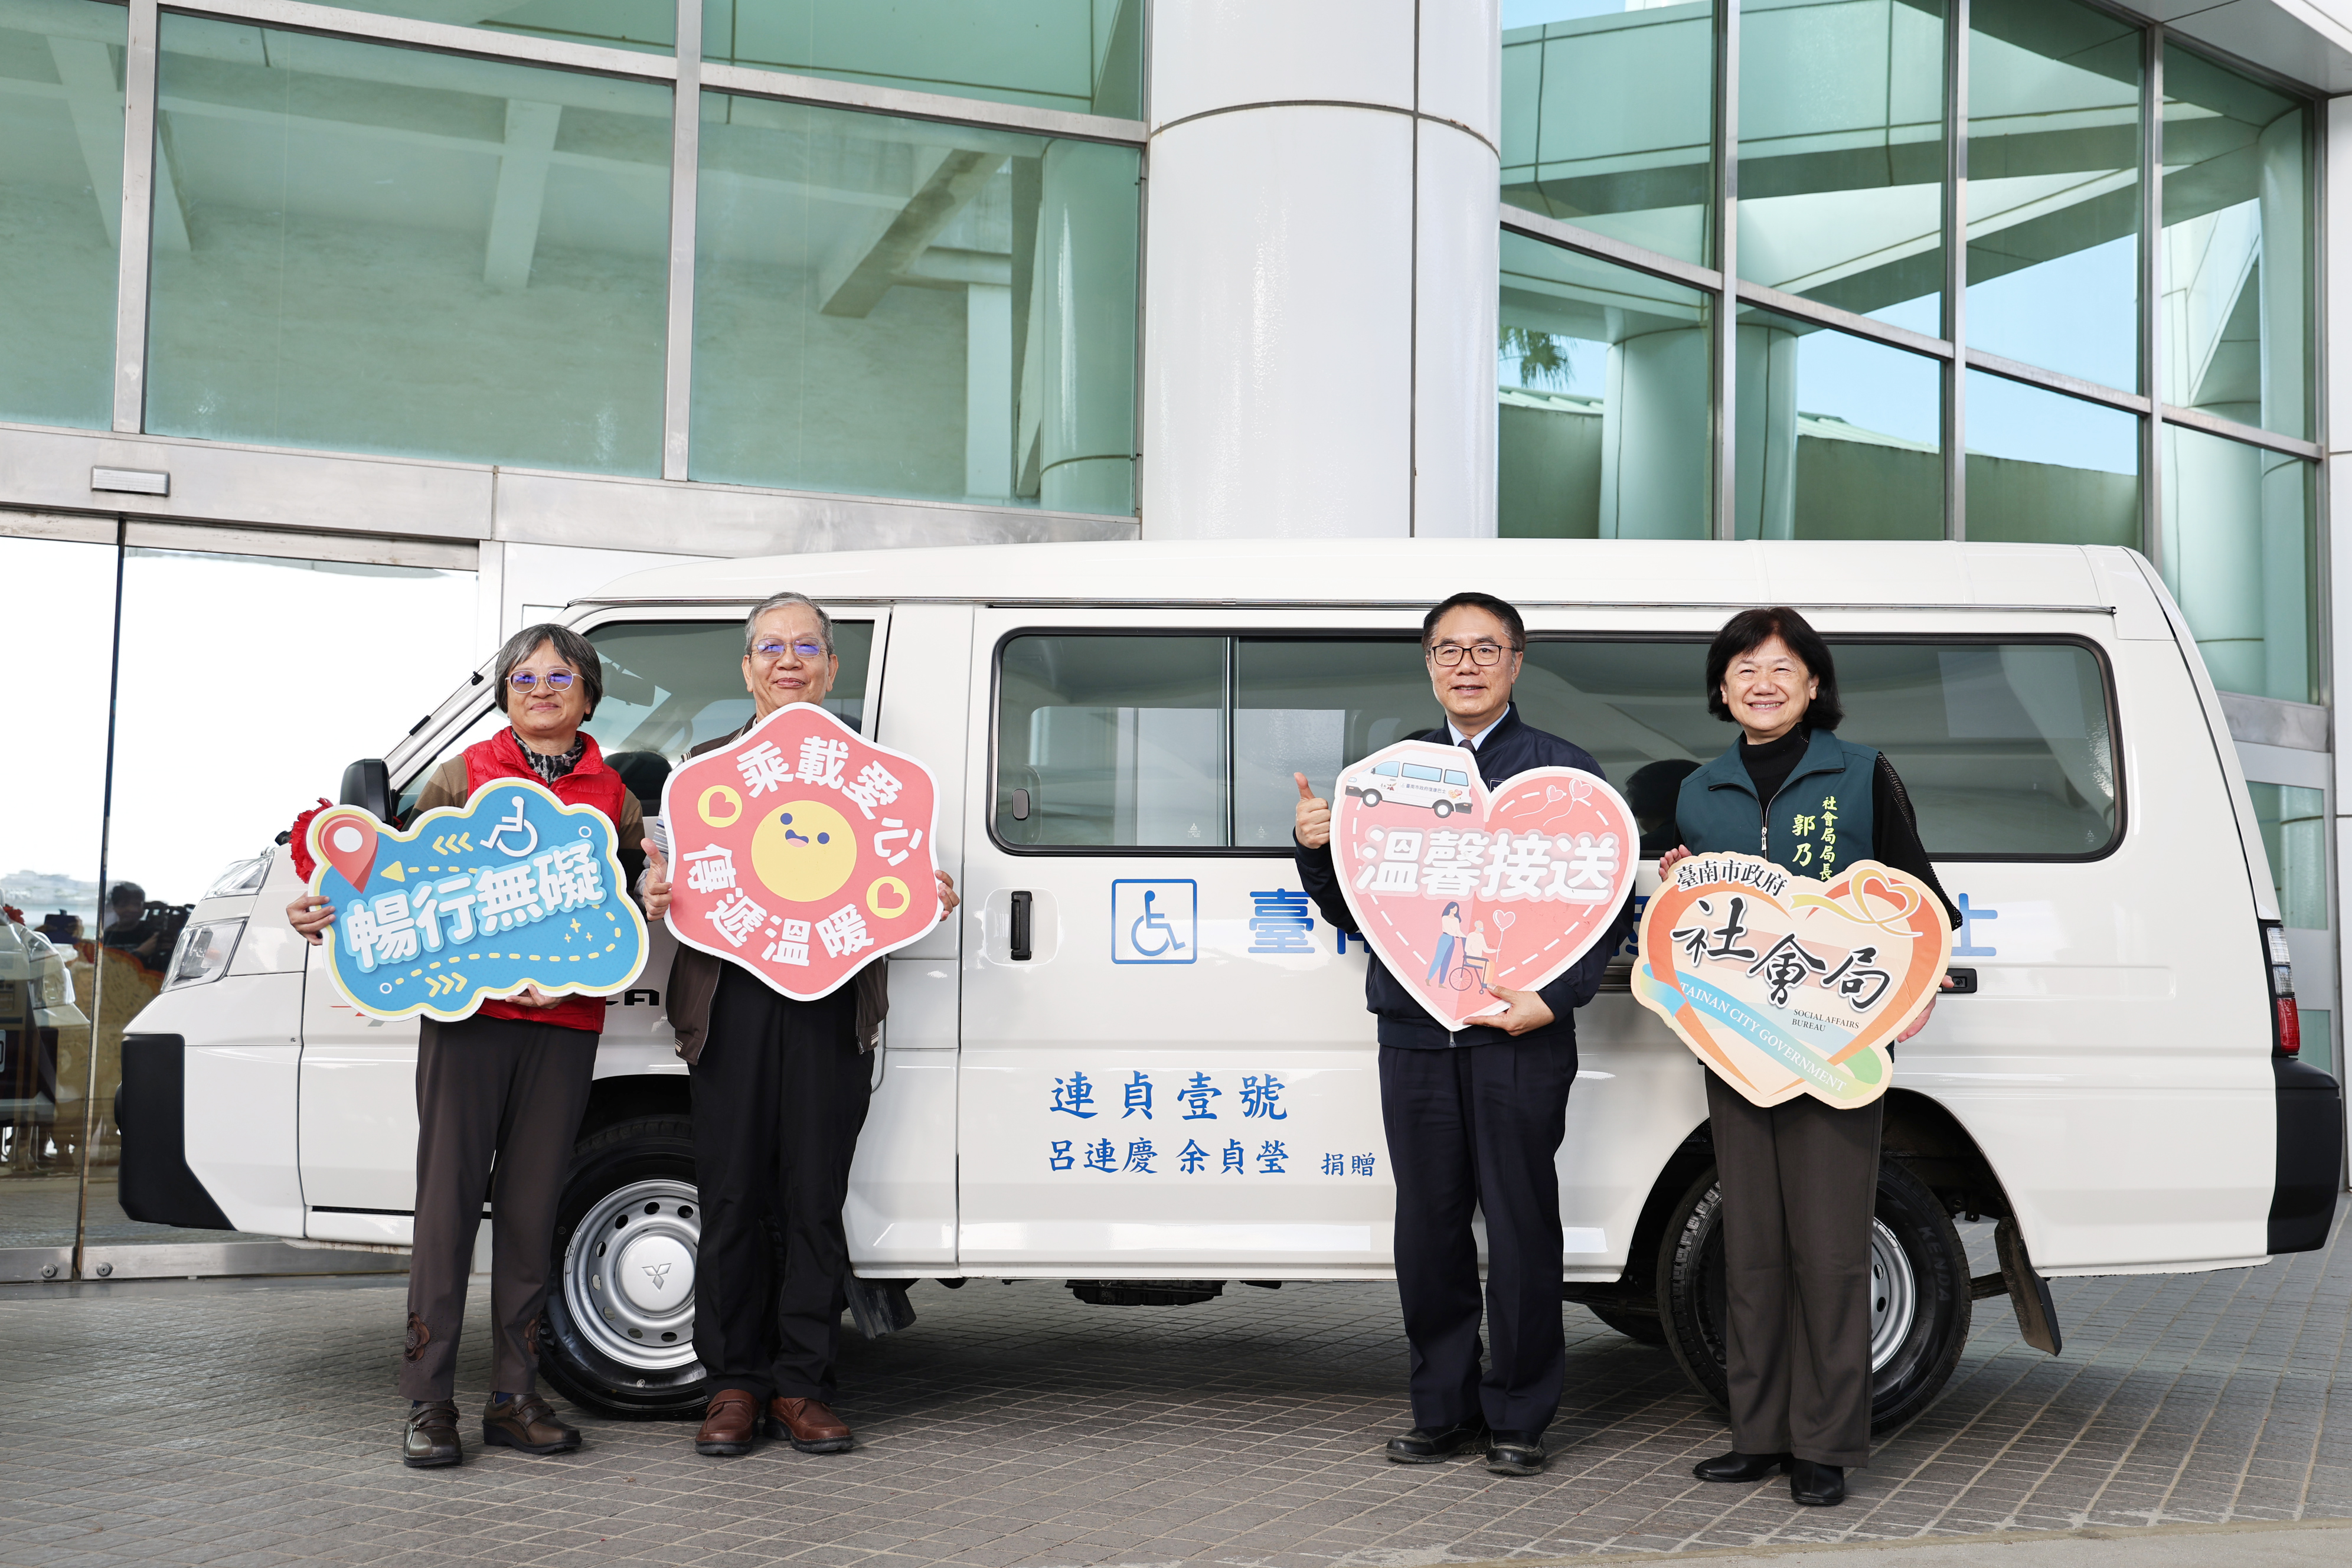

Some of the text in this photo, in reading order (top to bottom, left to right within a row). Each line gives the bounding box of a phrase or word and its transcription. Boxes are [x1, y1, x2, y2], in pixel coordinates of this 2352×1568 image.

[736, 736, 923, 866] 乘載愛心
[1356, 828, 1615, 901] 溫馨接送
[1674, 860, 1789, 896] 臺南市政府
[1792, 814, 1816, 878] 郭乃
[345, 842, 603, 969] 暢行無礙
[682, 843, 875, 967] 傳遞溫暖
[1672, 897, 1890, 1008] 社會局
[1680, 982, 1847, 1092] TAINAN CITY GOVERNMENT
[1792, 1018, 1826, 1032] BUREAU
[1794, 1009, 1860, 1029] SOCIAL AFFAIRS
[1049, 1070, 1288, 1121] 連貞壹號
[1048, 1136, 1376, 1177] 呂連慶 余貞瑩 捐贈
[1916, 1226, 1952, 1301] KENDA
